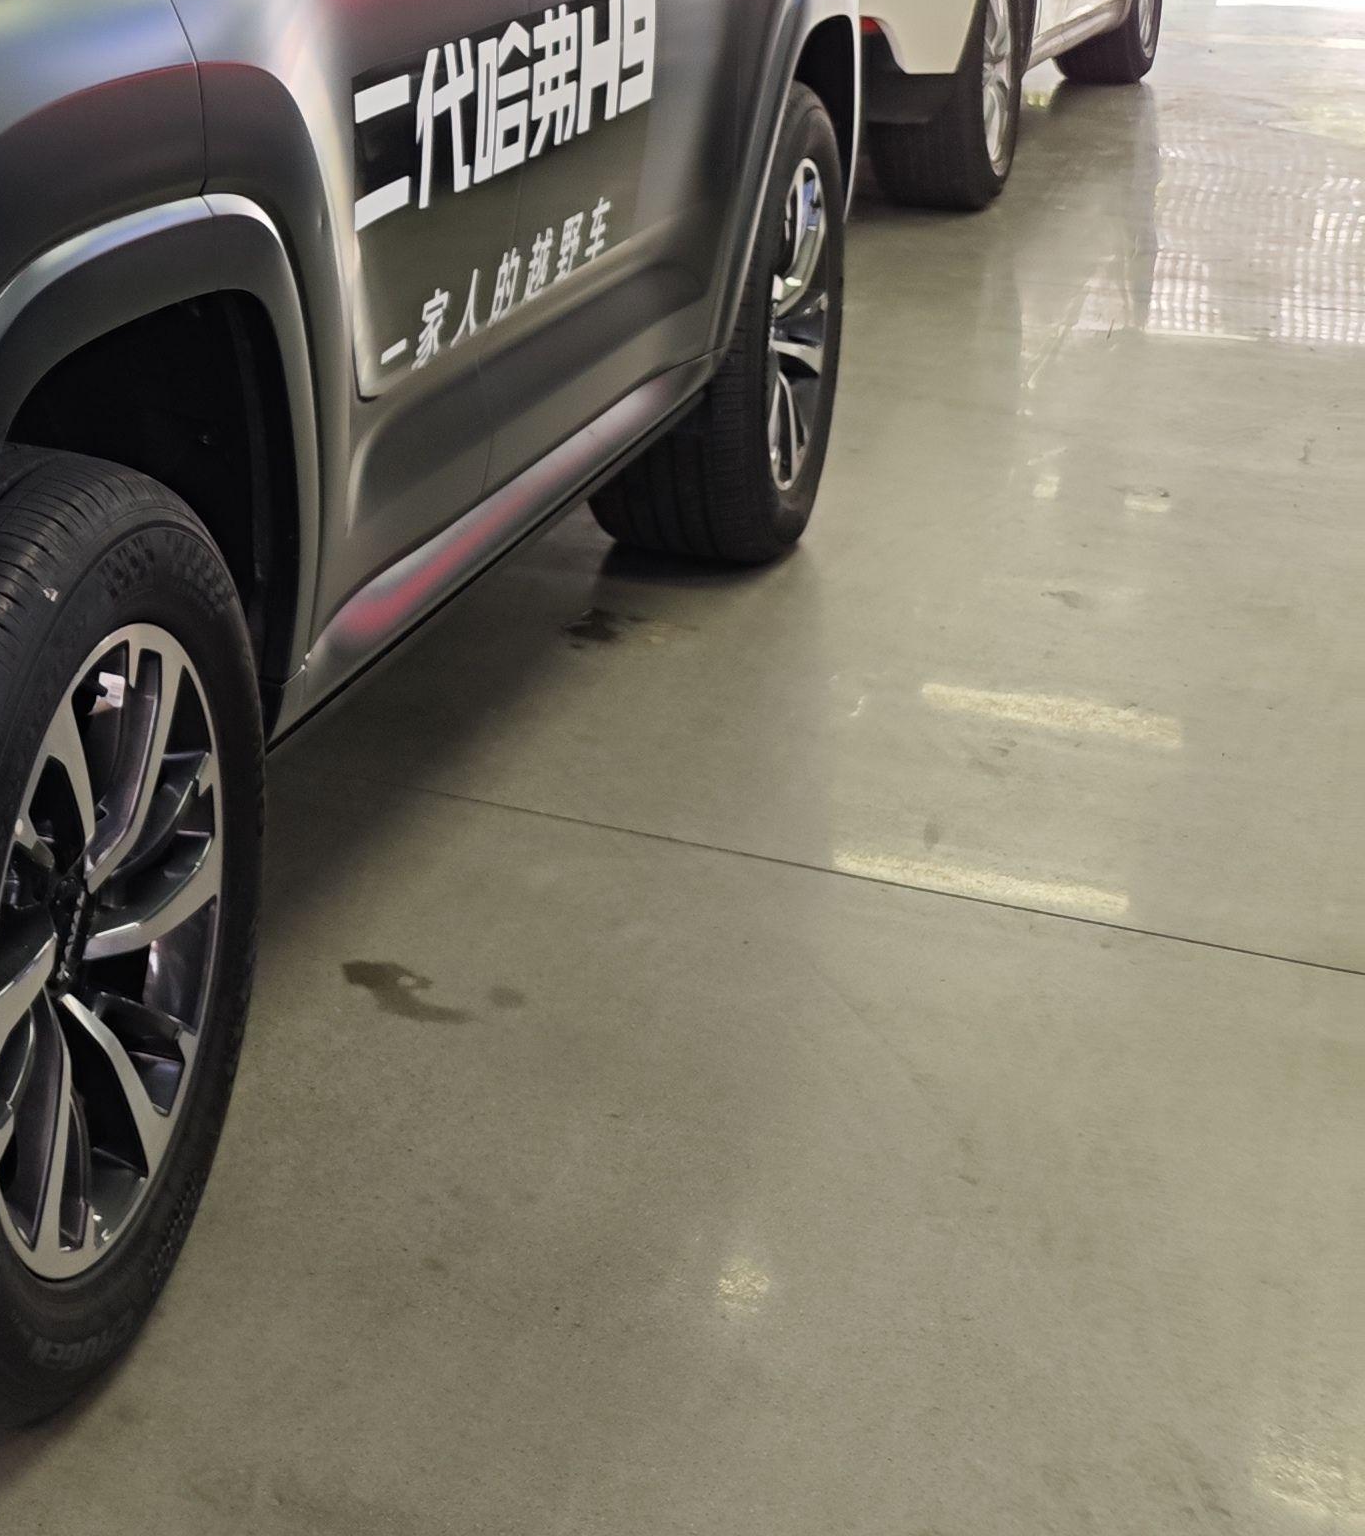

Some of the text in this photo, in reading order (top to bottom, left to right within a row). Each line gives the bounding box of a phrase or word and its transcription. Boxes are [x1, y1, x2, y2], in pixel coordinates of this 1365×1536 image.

[380, 197, 611, 370] 一家人的越野车
